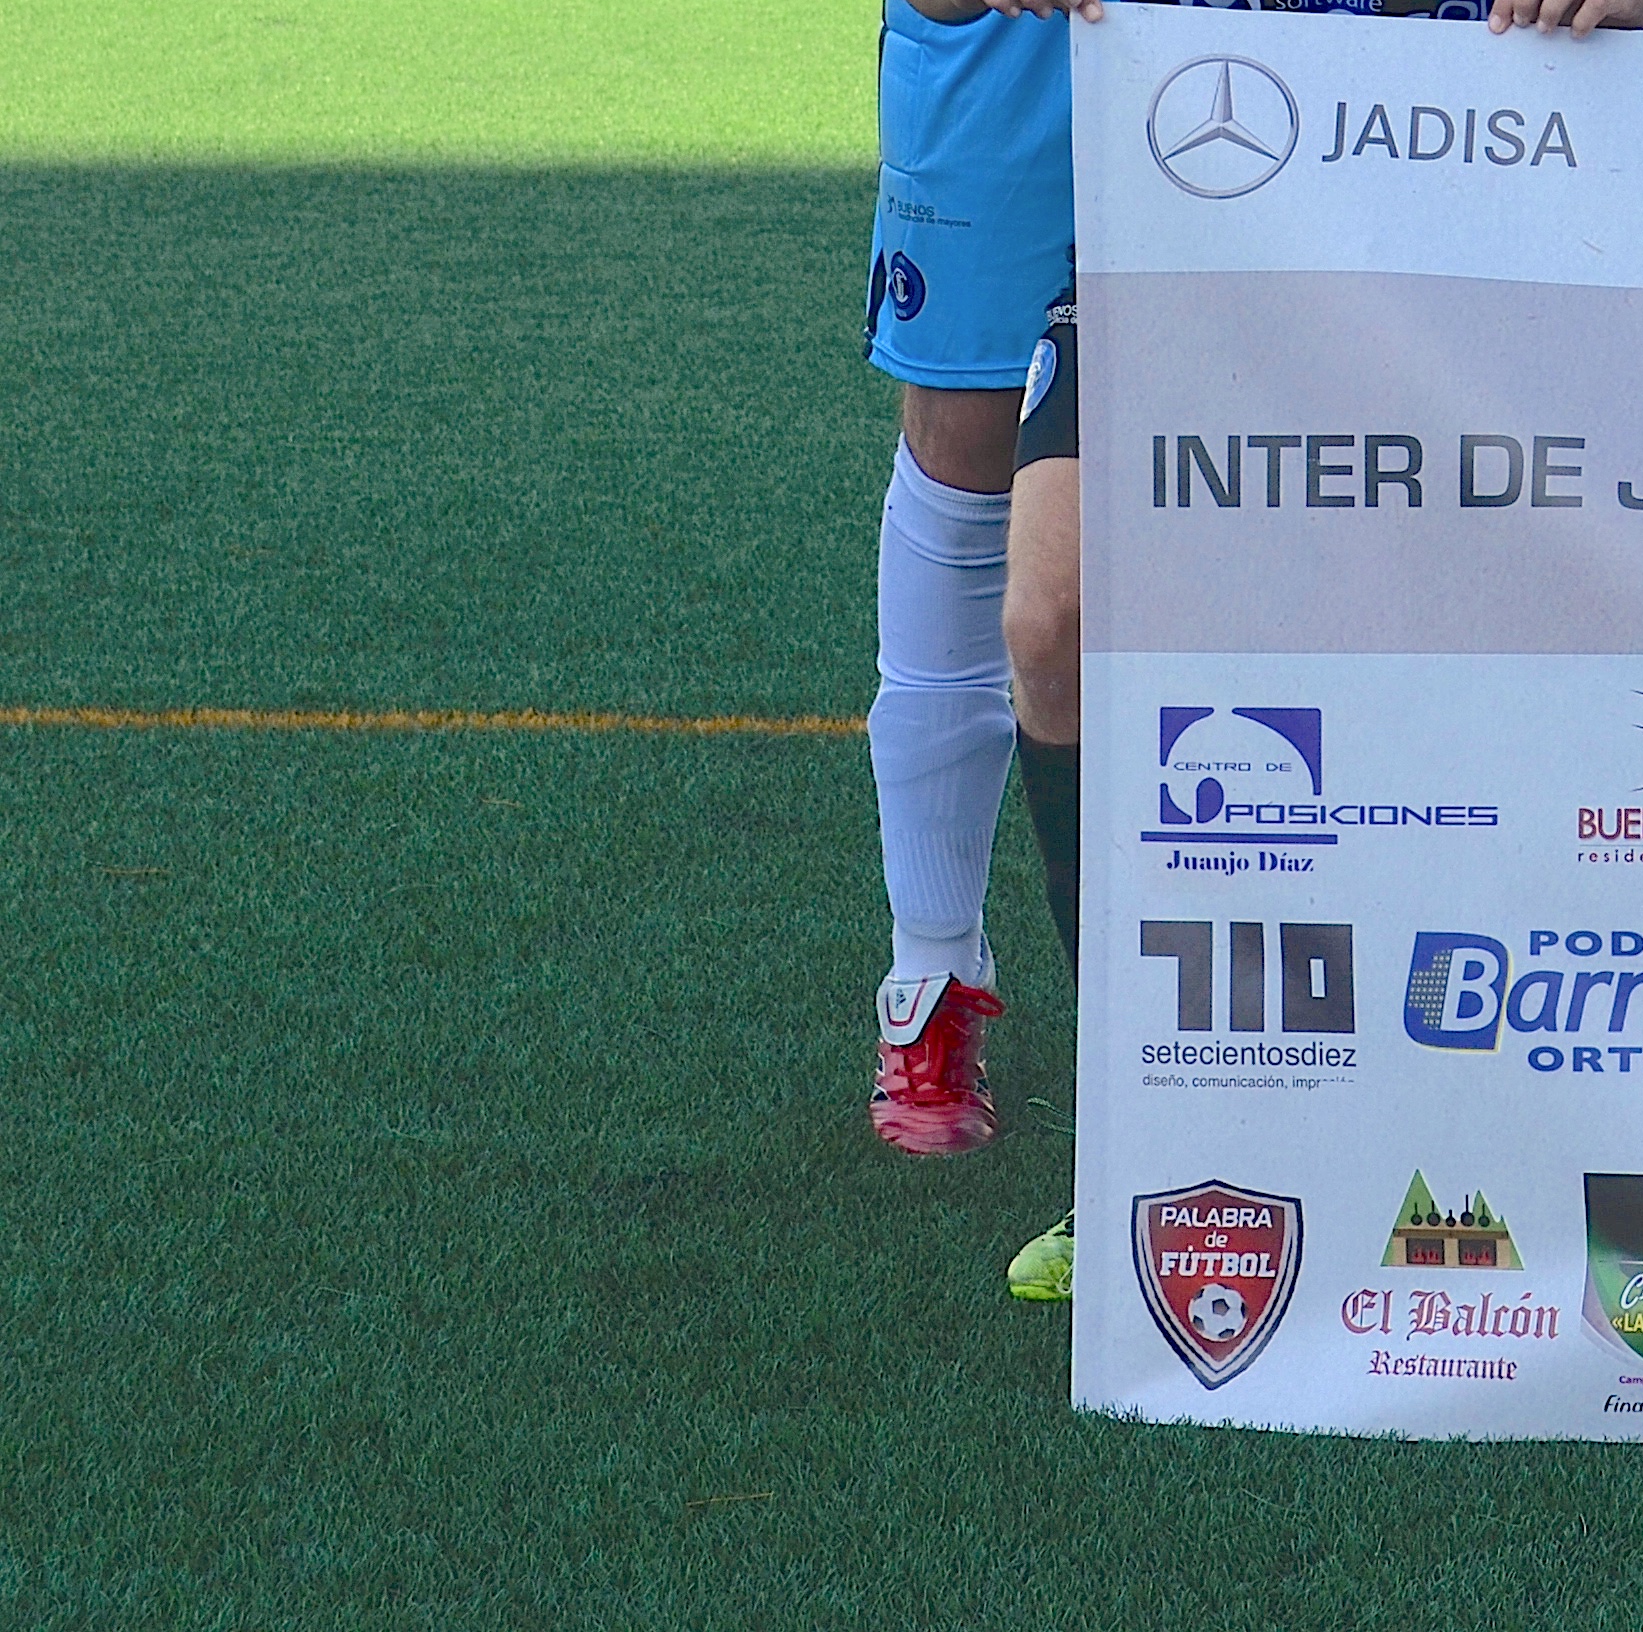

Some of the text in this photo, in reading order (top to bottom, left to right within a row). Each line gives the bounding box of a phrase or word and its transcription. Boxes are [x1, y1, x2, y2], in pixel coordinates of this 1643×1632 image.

[1322, 100, 1579, 169] JADISA
[1151, 432, 1425, 510] INTER
[1458, 433, 1589, 511] DE
[1173, 761, 1293, 772] CENTRO DE
[1166, 850, 1315, 876] Juanjo Díaz
[1141, 1040, 1357, 1069] setecientosdiez
[1142, 1073, 1188, 1089] diseño,
[1192, 1074, 1288, 1090] comunicación,
[1160, 1204, 1273, 1231] PALABRA
[1204, 1232, 1228, 1250] de
[1158, 1243, 1277, 1280] FÚTBOL
[1340, 1289, 1560, 1340] El Balcón
[1367, 1349, 1518, 1382] Restaurante
